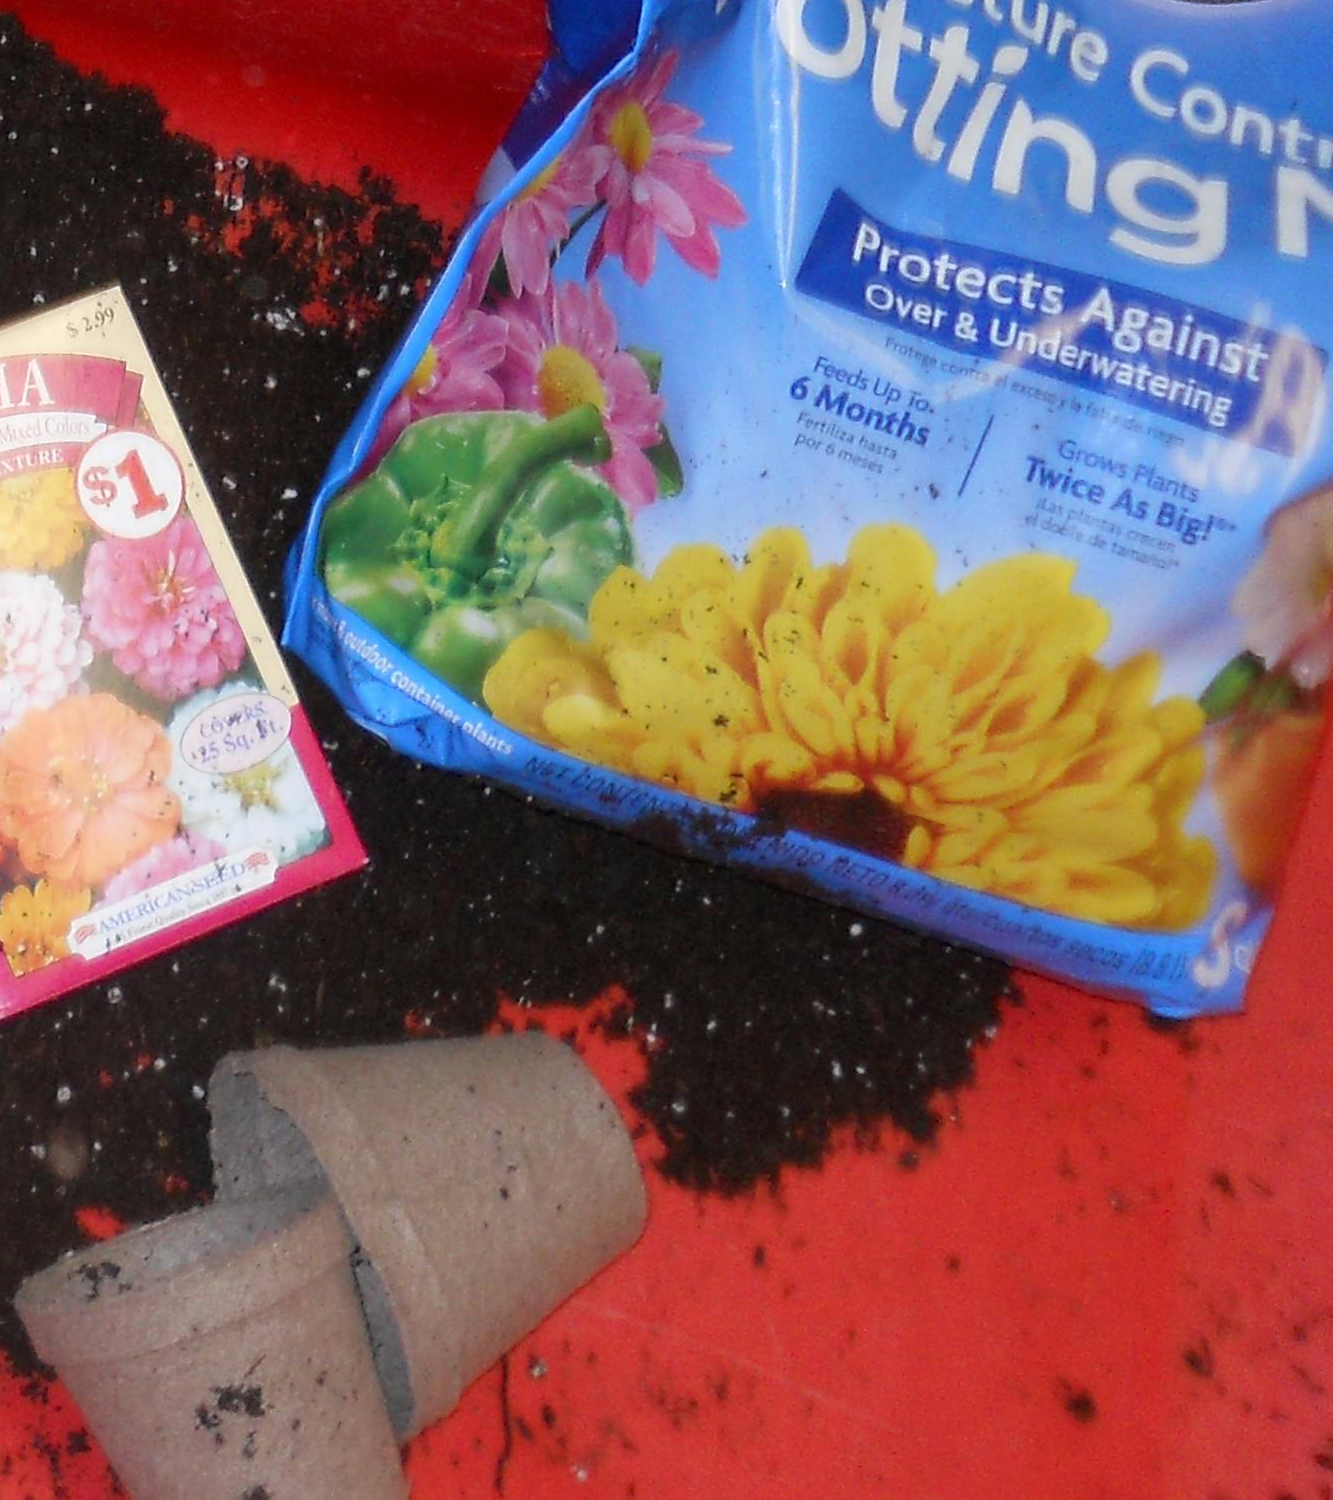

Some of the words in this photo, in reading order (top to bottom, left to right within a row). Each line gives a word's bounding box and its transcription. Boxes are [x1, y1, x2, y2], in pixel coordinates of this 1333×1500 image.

[852, 223, 1064, 315] Protects
[1080, 286, 1270, 383] Against
[813, 356, 868, 390] Feeds
[873, 378, 901, 406] Up
[864, 284, 958, 331] Over
[954, 312, 978, 342] &
[989, 320, 1233, 428] Underwatering
[44, 416, 90, 435] Colors
[790, 376, 811, 400] 6
[813, 384, 931, 448] Months
[797, 412, 856, 444] Fertiliza
[859, 432, 898, 460] hasta
[82, 449, 168, 518] $1
[794, 432, 822, 451] por
[826, 443, 835, 456] 6
[838, 450, 885, 475] meses
[1059, 439, 1127, 478] Grows
[1133, 463, 1200, 503] Plants
[1025, 455, 1105, 505] Twice
[1111, 488, 1150, 520] As
[344, 631, 394, 674] outdoor
[390, 670, 464, 728] container
[199, 701, 268, 738] COVERS
[98, 885, 190, 934] AMERICAN
